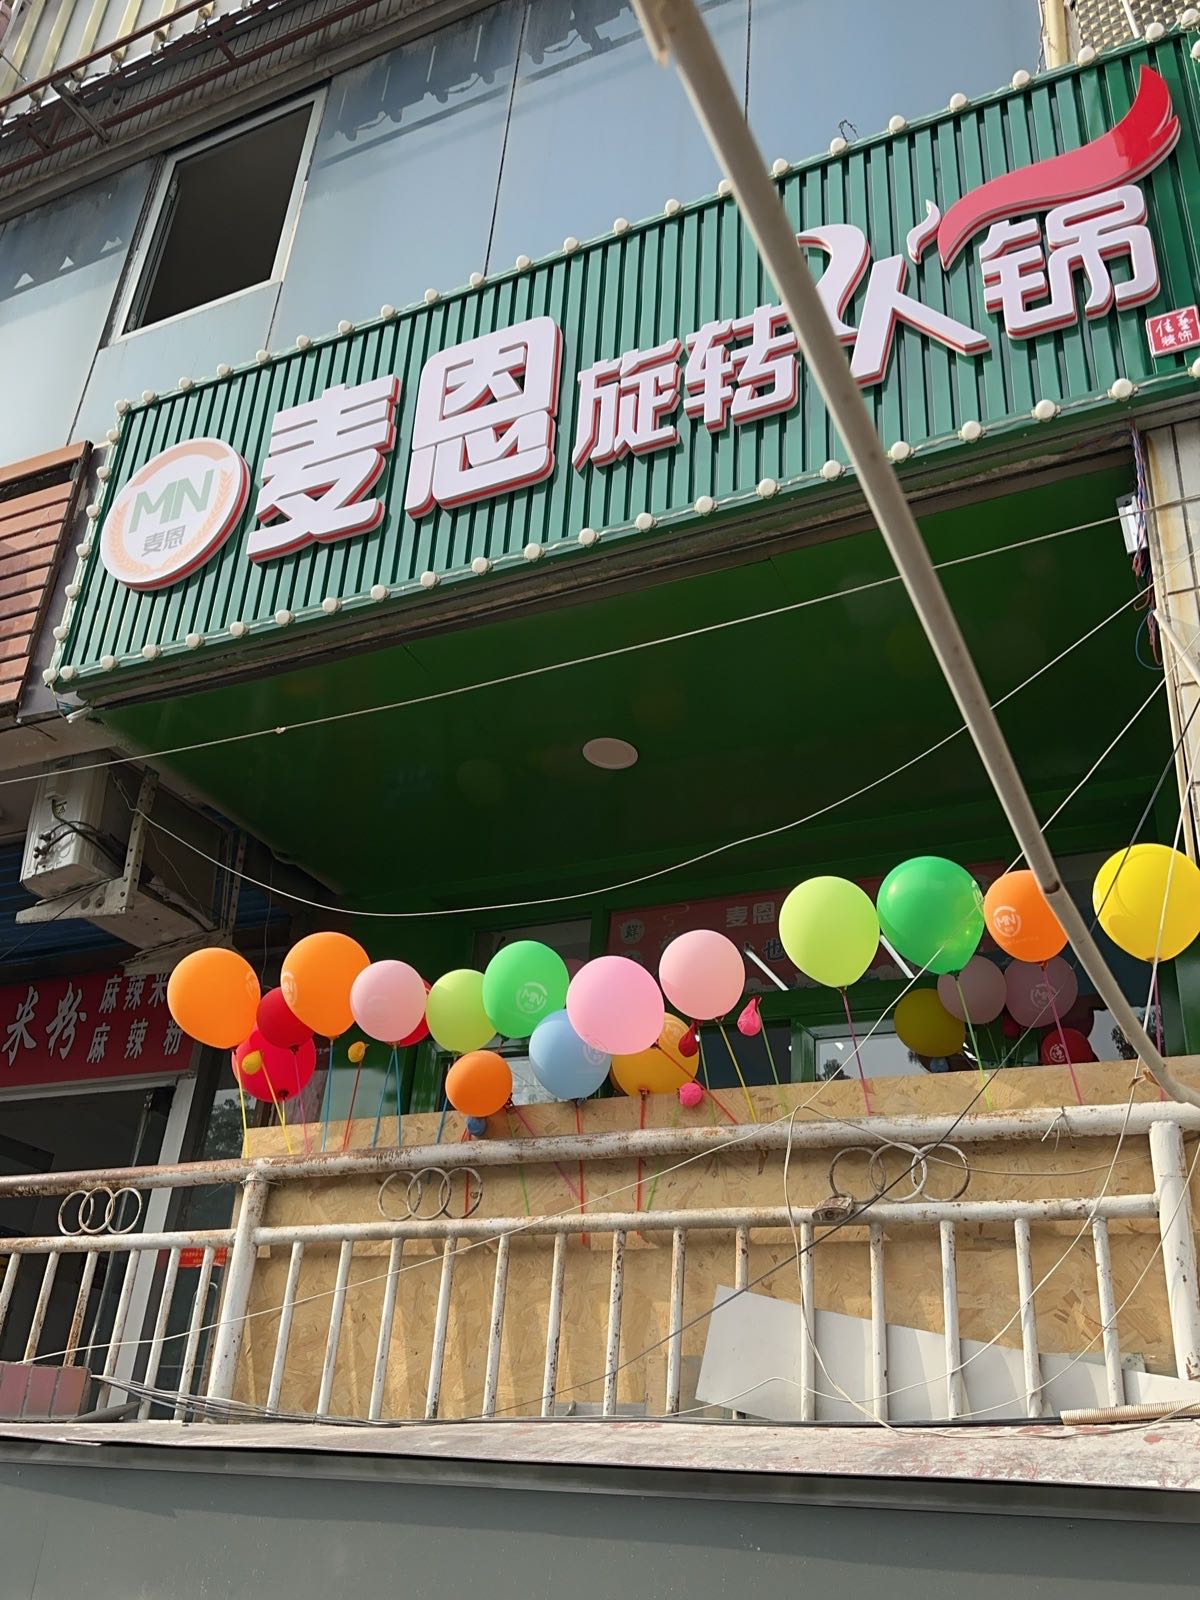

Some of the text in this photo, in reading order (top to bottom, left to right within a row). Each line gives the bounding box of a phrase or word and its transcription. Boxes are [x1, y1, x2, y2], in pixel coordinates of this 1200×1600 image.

[129, 469, 214, 533] MN
[141, 525, 186, 557] 麦恩
[3, 985, 87, 1067] 米粉
[87, 1018, 183, 1064] 麻辣粉
